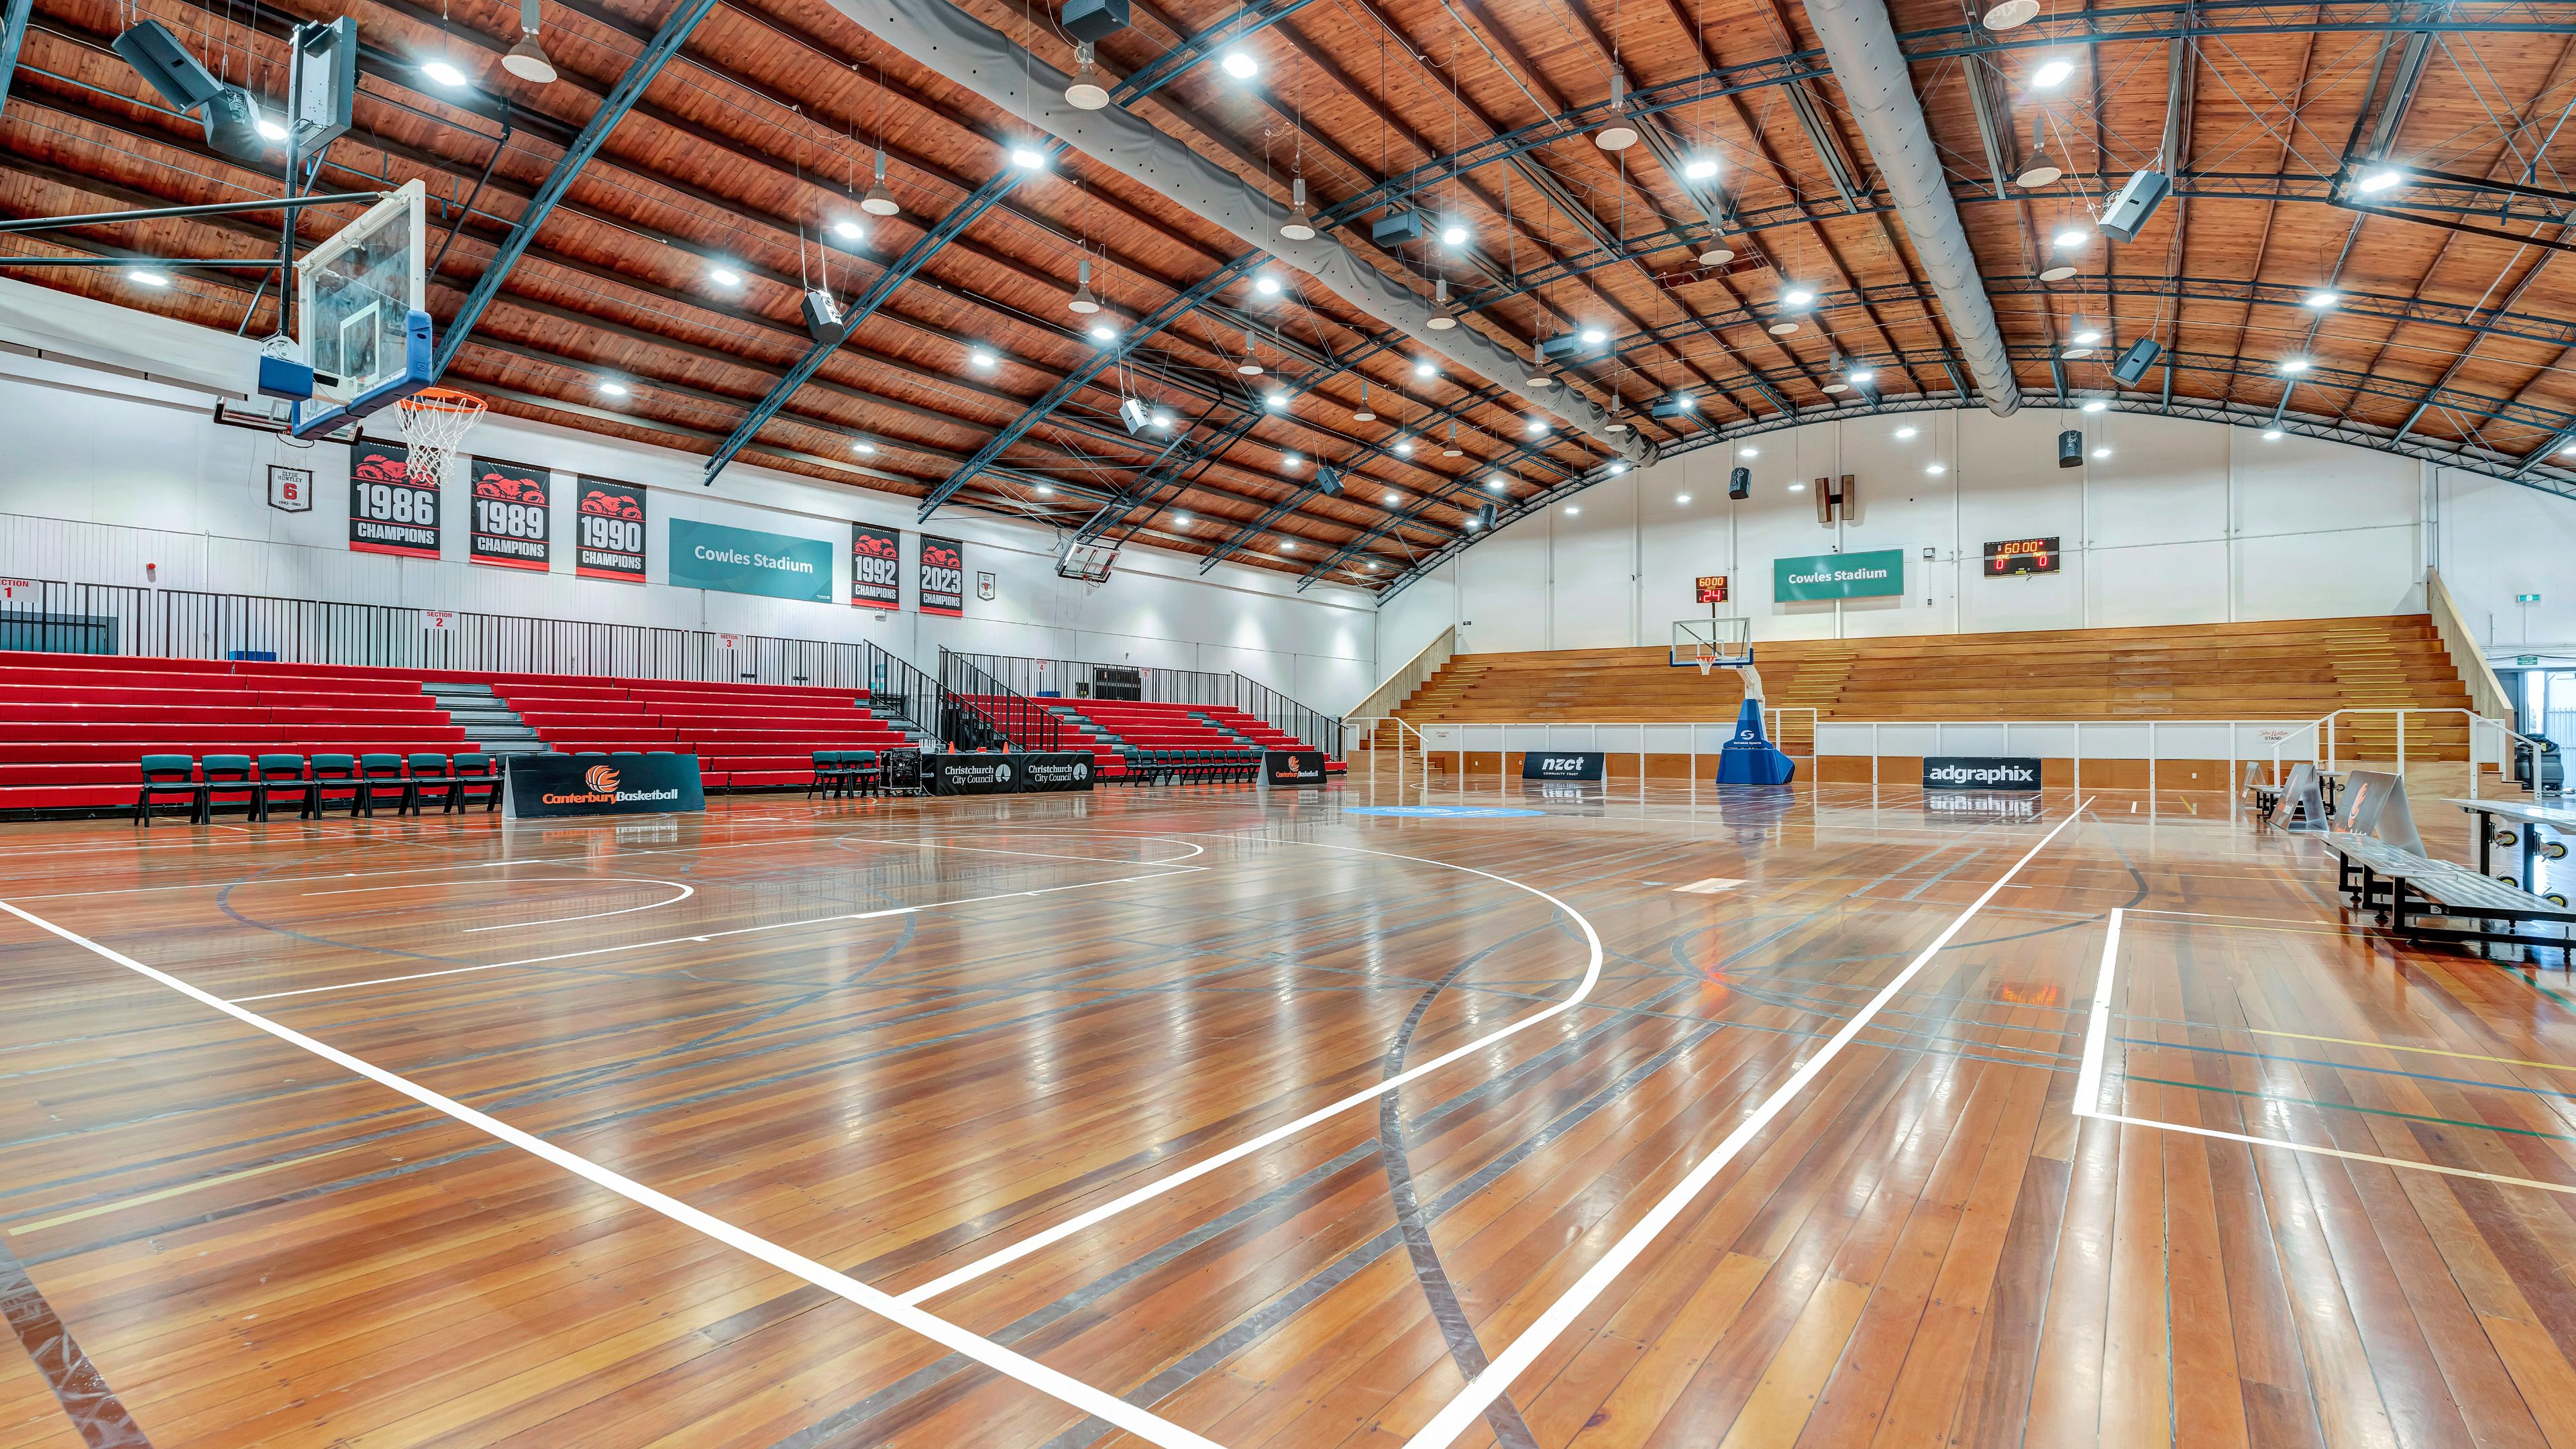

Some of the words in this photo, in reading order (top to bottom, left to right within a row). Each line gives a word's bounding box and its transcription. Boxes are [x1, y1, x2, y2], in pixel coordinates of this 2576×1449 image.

[284, 483, 297, 500] 6
[357, 483, 433, 525] 1986
[477, 500, 543, 539] 1989
[358, 522, 434, 545] CHAMPIONS
[582, 516, 641, 552] 1990
[478, 537, 545, 557] CHAMPIONS
[2005, 541, 2037, 553] 60:00
[582, 550, 641, 570] CHAMPIONS
[694, 545, 751, 565] Cowles
[753, 553, 813, 574] Stadium
[855, 555, 896, 586] 1992
[1788, 572, 1832, 584] Cowles
[1834, 568, 1887, 581] Stadium
[922, 566, 961, 594] 2023
[1699, 578, 1723, 586] 60:00
[4, 587, 11, 598] 1
[855, 584, 896, 600] CHAMPIONS
[923, 592, 960, 607] CHAMPIONS
[1704, 590, 1720, 602] 24
[436, 618, 443, 627] 2
[727, 639, 732, 647] 3
[945, 765, 994, 775] Christchurch
[1028, 765, 1072, 773] Christchurch
[1542, 757, 1584, 771] nzct
[953, 775, 966, 786] City
[967, 775, 993, 784] Council
[1034, 774, 1048, 784] City
[1049, 773, 1071, 782] Council
[1929, 765, 2033, 784] adgraphix
